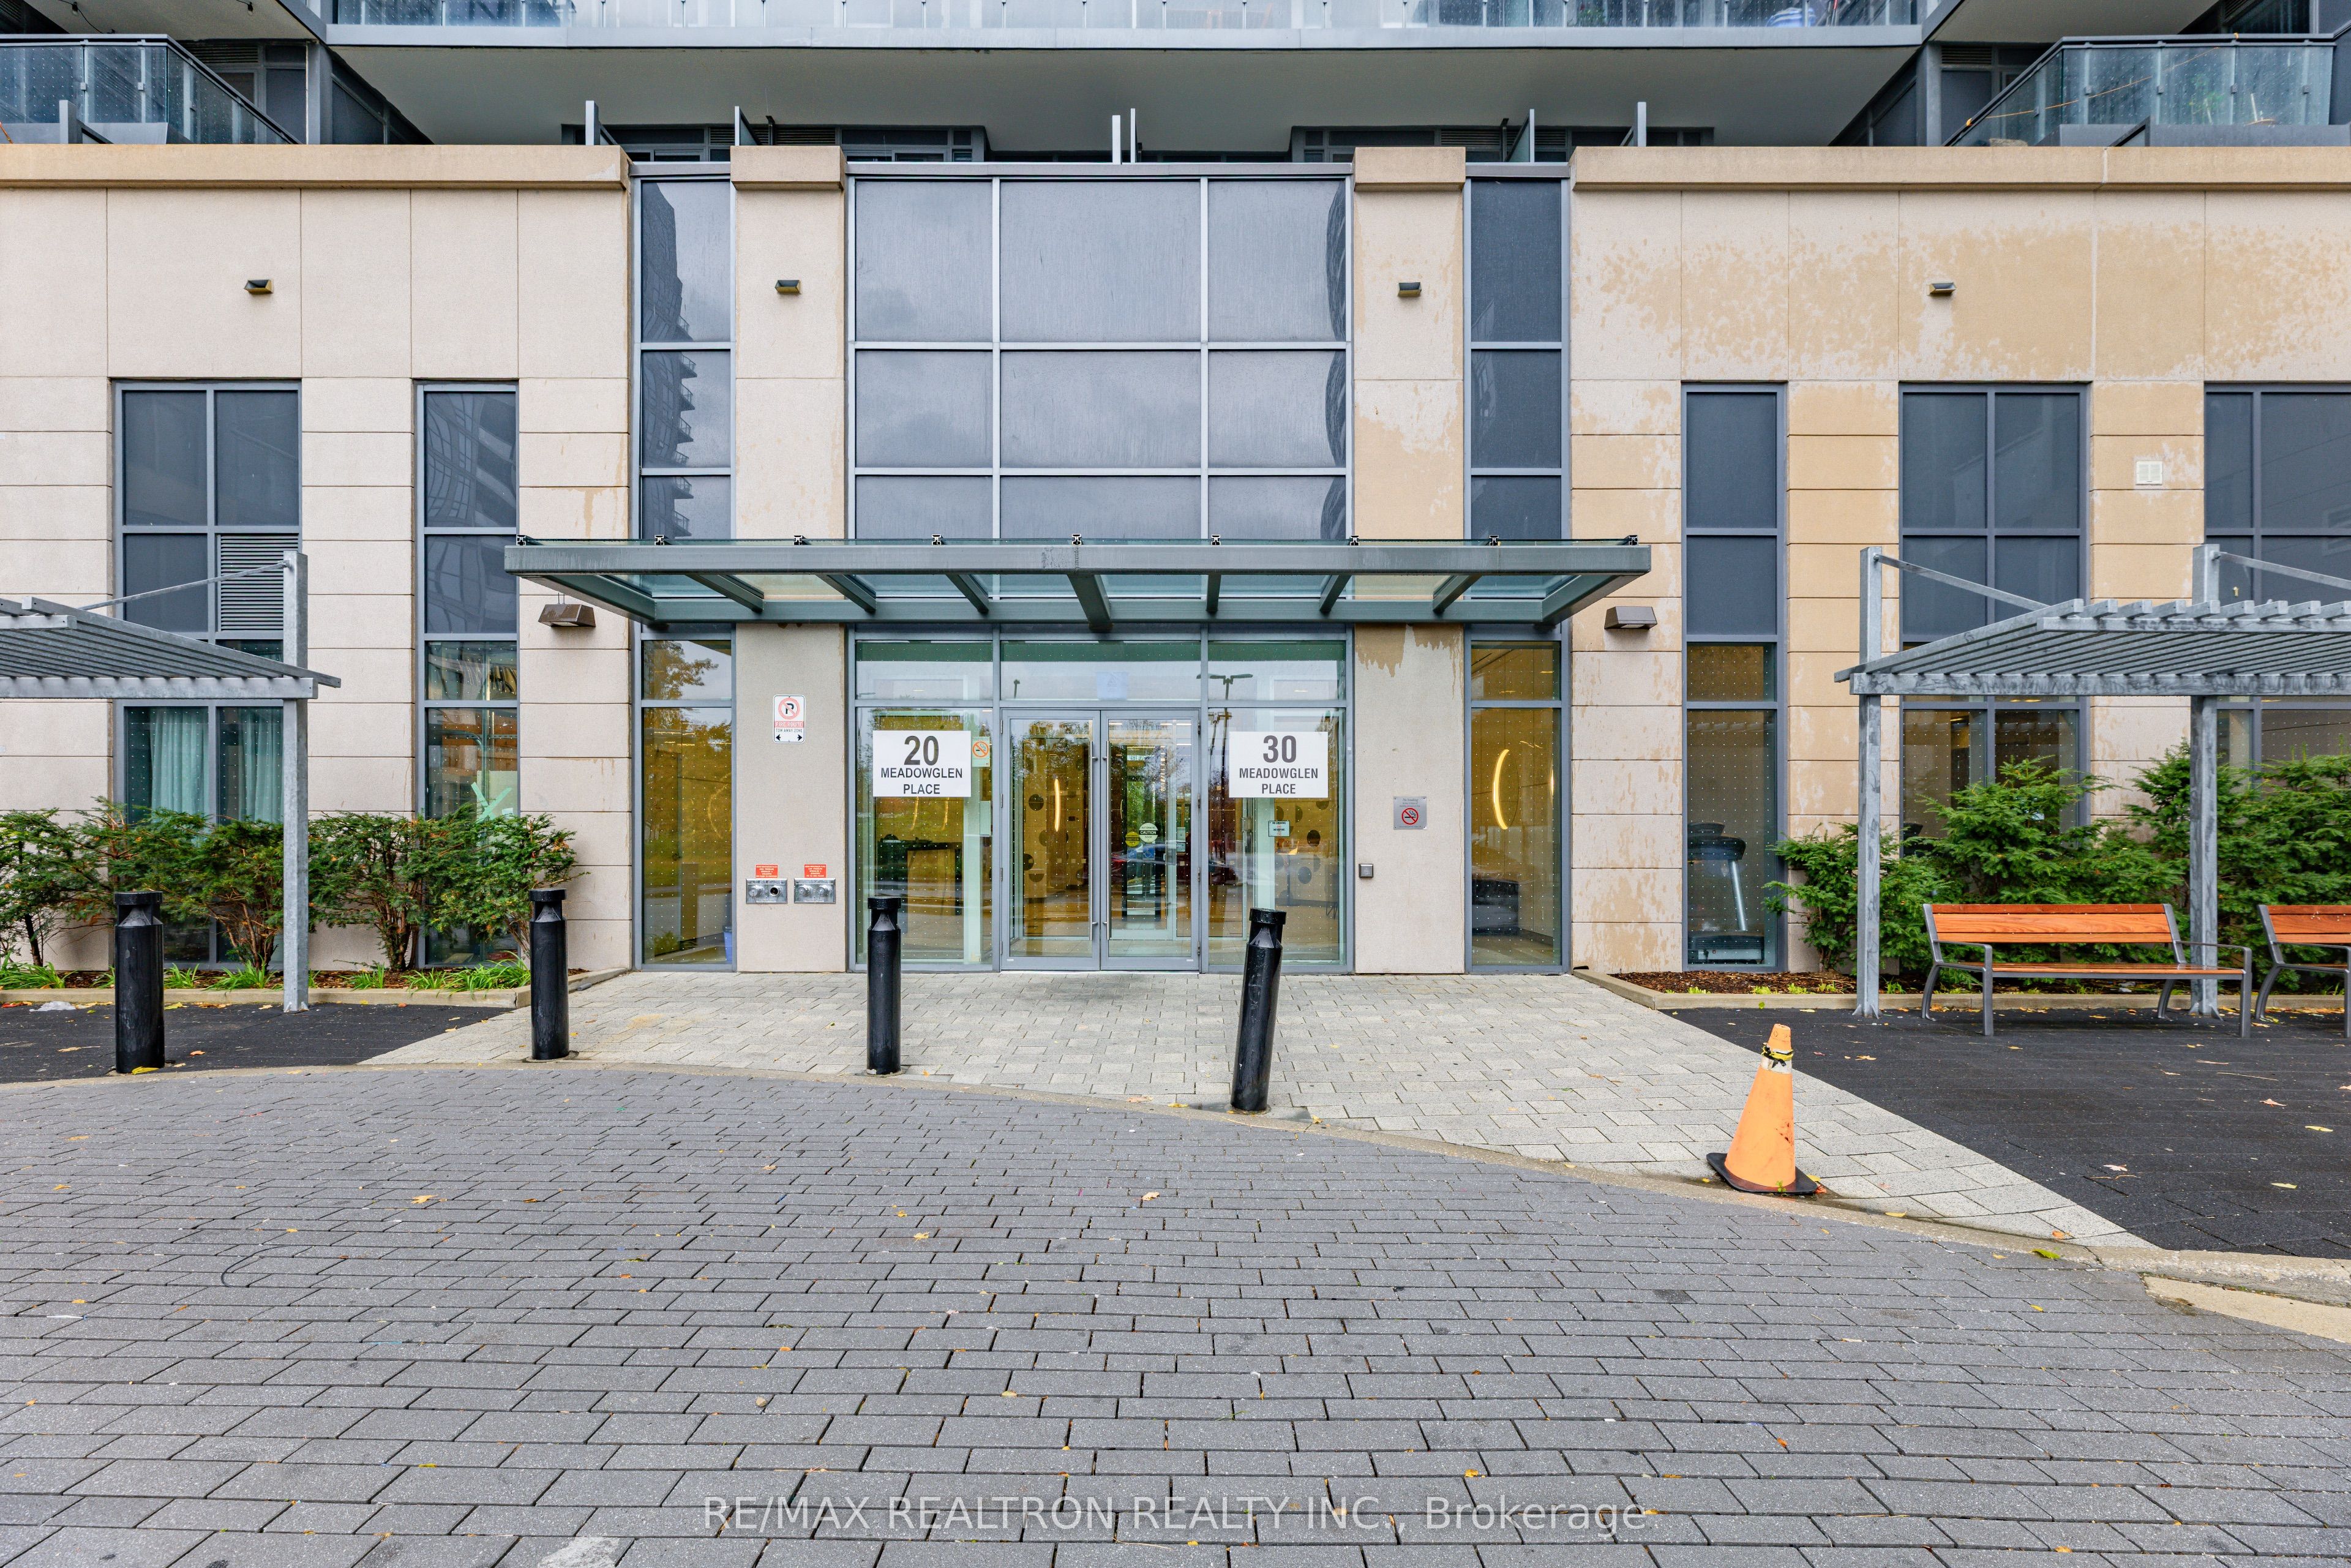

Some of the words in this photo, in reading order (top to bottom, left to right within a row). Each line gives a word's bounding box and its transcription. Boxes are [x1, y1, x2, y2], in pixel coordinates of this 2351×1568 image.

[904, 735, 939, 766] 20
[1263, 735, 1297, 763] 30
[881, 767, 962, 778] MEADOWGLEN
[1239, 768, 1318, 779] MEADOWGLEN
[903, 784, 940, 795] PLACE
[1262, 783, 1296, 794] PLACE
